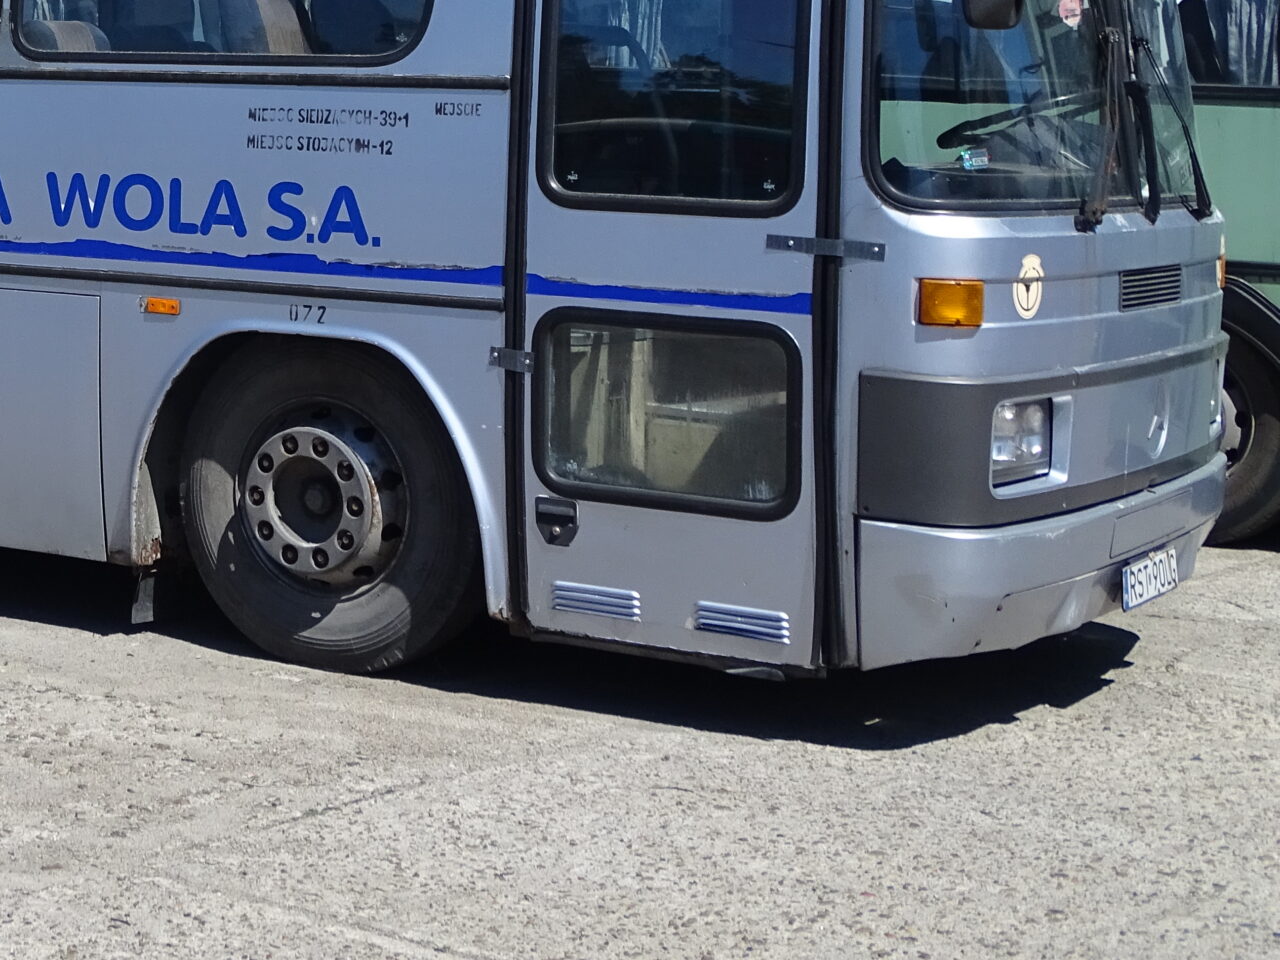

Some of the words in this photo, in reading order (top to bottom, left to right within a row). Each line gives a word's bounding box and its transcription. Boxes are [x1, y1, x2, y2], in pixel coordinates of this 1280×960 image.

[435, 101, 482, 117] WEJSCIE
[246, 135, 293, 151] MIEJSC
[46, 171, 248, 238] WOLA
[266, 181, 381, 247] S.A.
[289, 304, 327, 324] 072
[1129, 565, 1149, 602] RST
